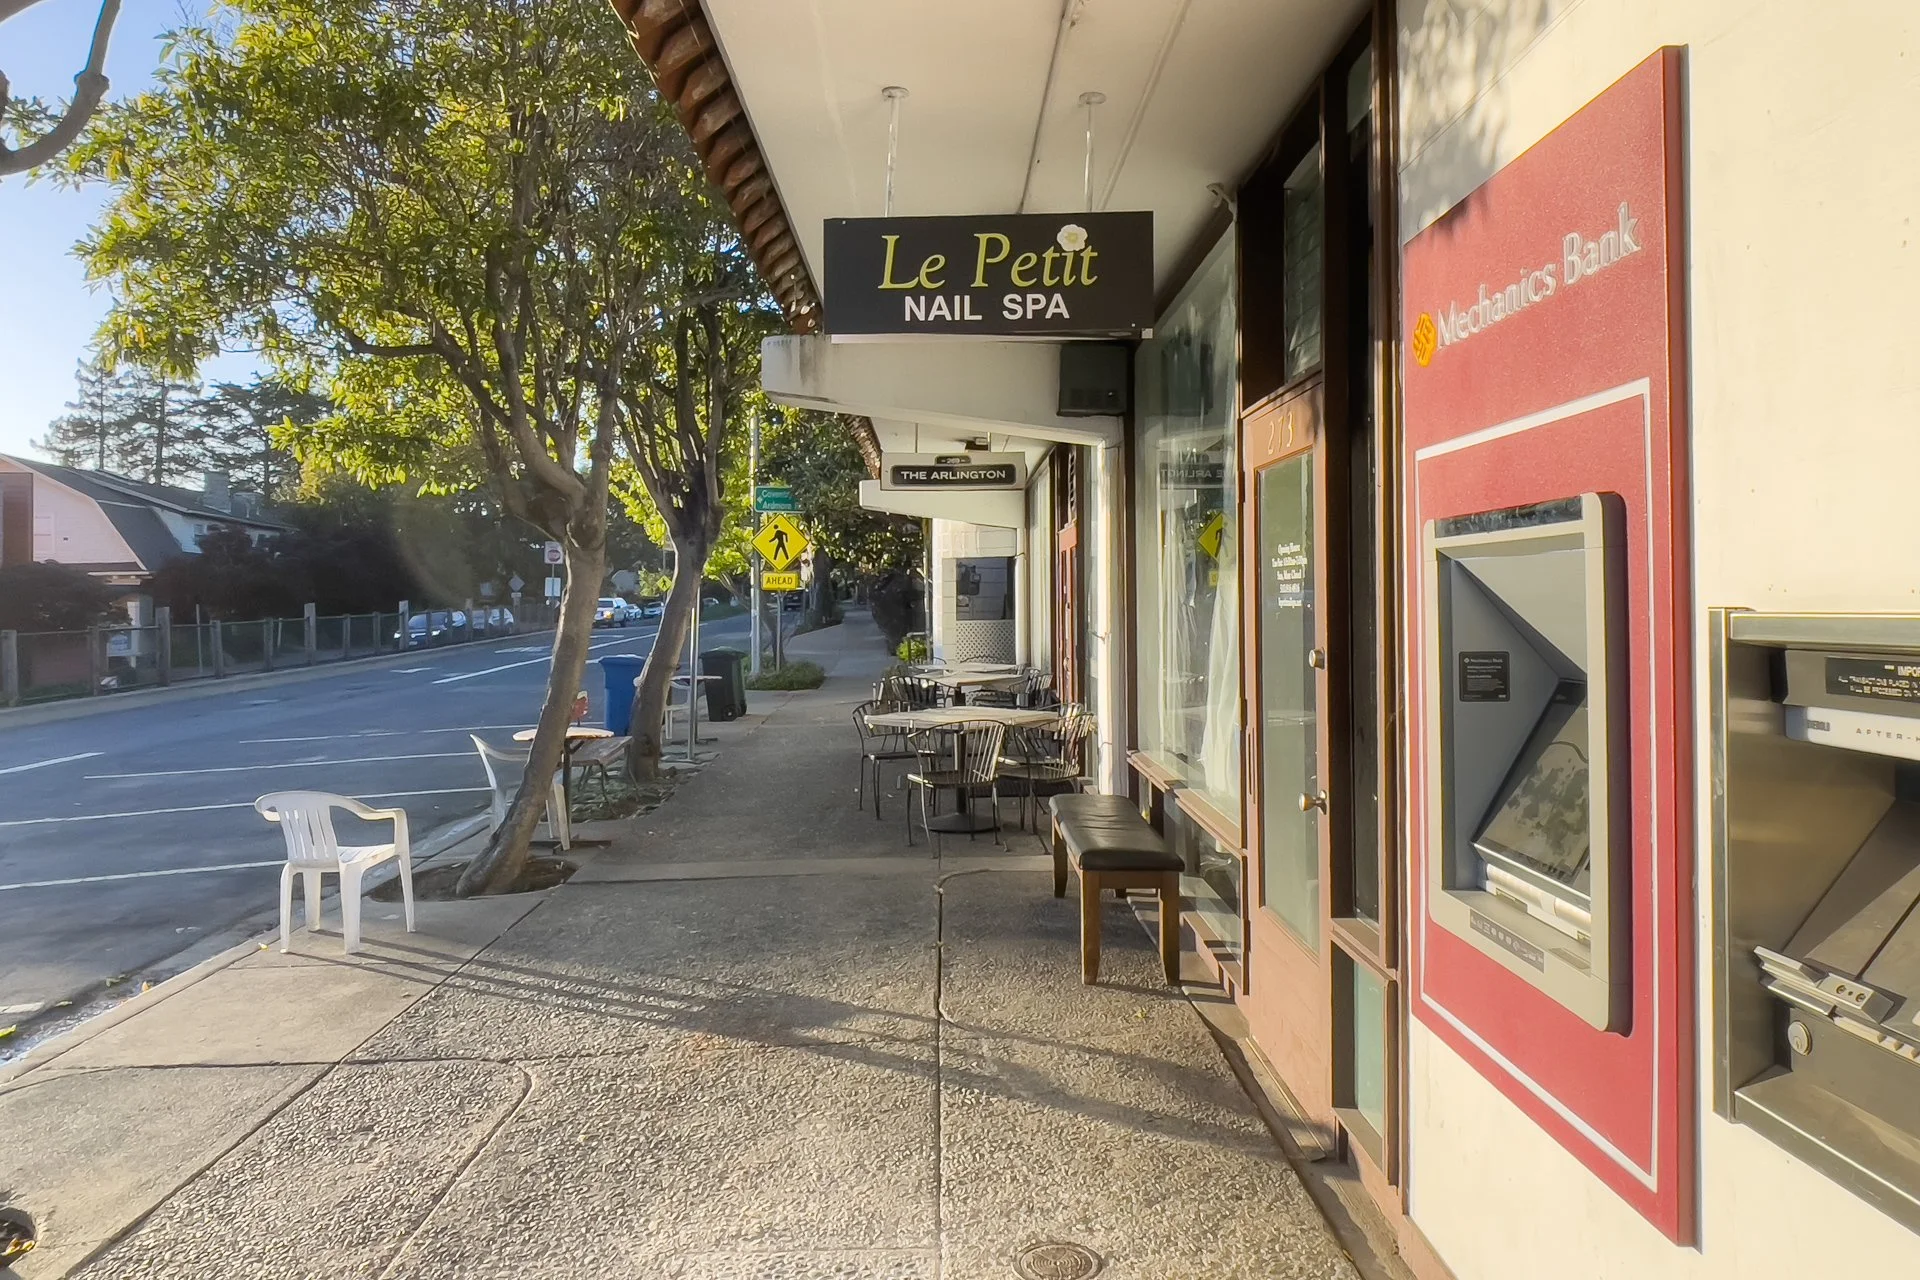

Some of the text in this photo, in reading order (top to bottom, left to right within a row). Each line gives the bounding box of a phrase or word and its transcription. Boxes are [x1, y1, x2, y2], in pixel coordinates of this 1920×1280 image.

[877, 233, 1098, 289] Le Petit
[1437, 201, 1641, 350] Mechanics Bank
[904, 293, 1070, 321] NAIL SPA
[901, 470, 1006, 480] THE ARLINGTON
[766, 576, 793, 584] AHEAD
